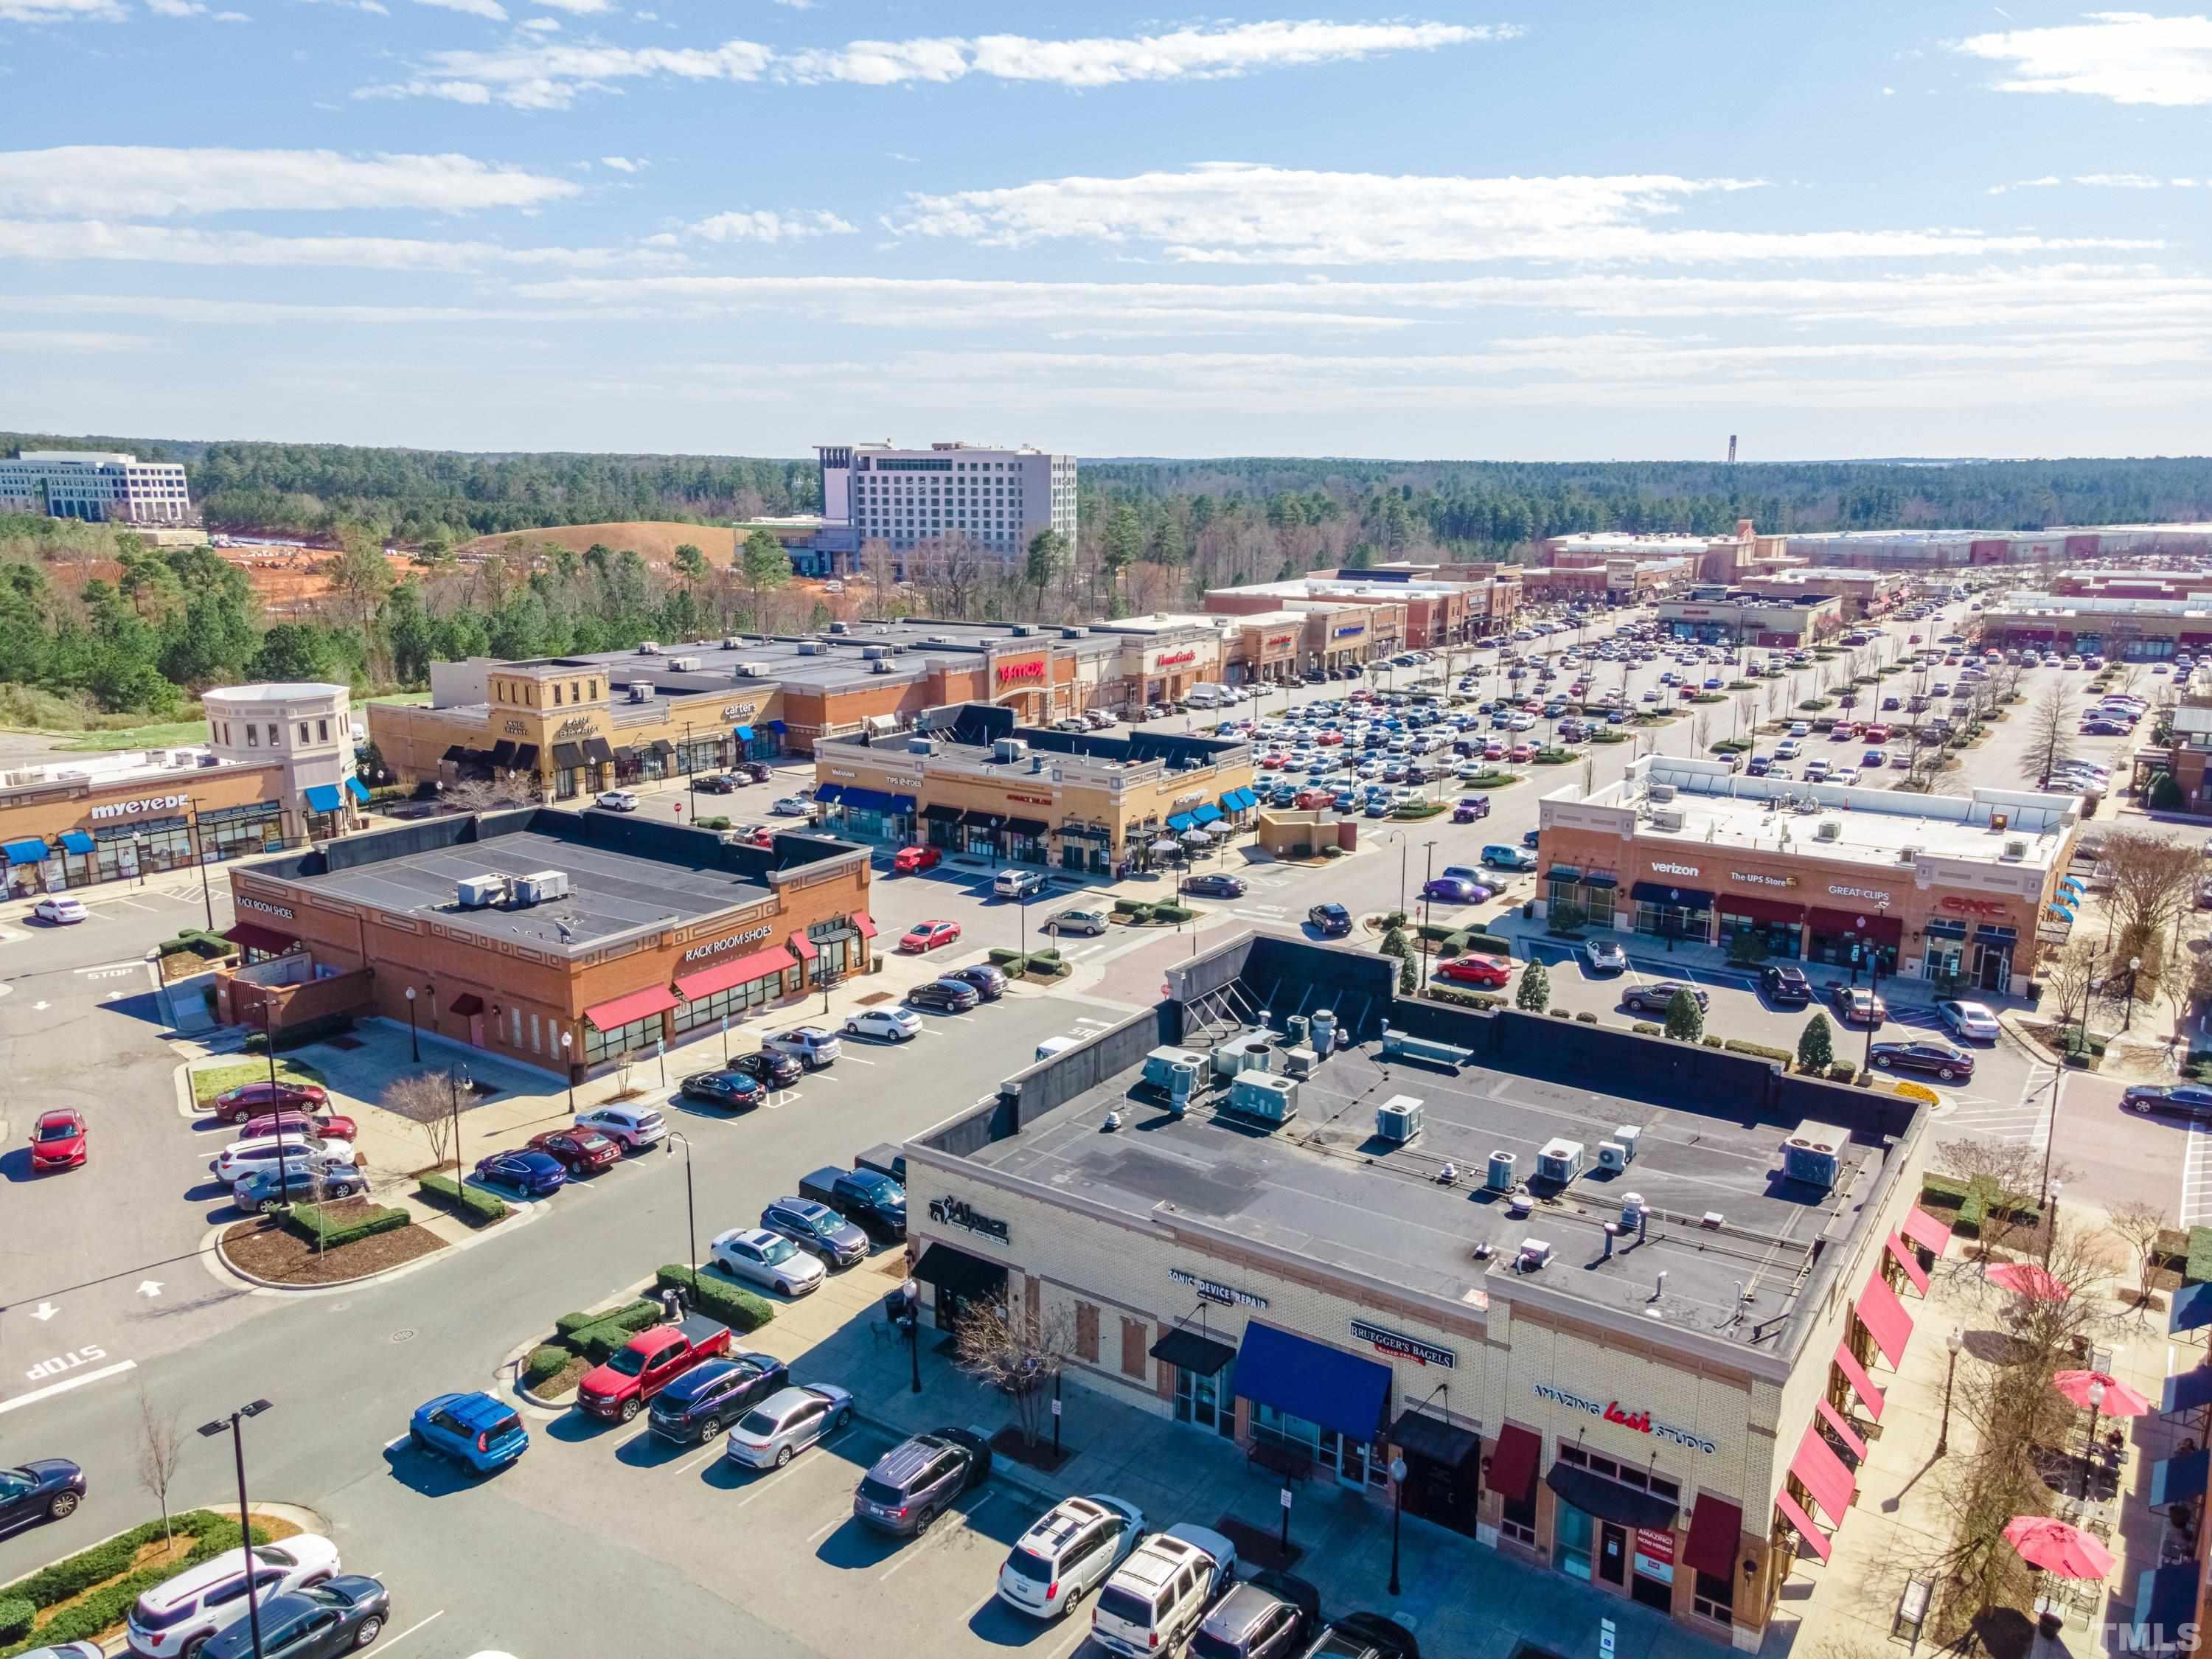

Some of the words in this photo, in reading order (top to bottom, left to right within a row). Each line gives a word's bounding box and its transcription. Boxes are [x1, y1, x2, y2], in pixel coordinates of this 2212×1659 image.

[1652, 862, 1699, 877] verizon
[1731, 872, 1746, 880] The
[1747, 874, 1764, 883] UPS
[1765, 876, 1787, 886] Store
[1829, 886, 1860, 897] GREAT
[1863, 890, 1889, 900] CLIPS
[237, 896, 253, 909] RACK
[254, 900, 273, 914] ROOM
[273, 905, 294, 919] SHOES
[1941, 897, 2006, 916] GNC
[684, 944, 712, 961] RACK
[713, 934, 745, 953] ROOM
[744, 925, 773, 943] SHOES
[87, 968, 133, 980] STOP
[1167, 1270, 1194, 1287] SONIC
[1199, 1281, 1230, 1299] DEVICE
[1235, 1292, 1267, 1310] REPAIR
[1350, 1326, 1411, 1352] BRUEGGER'S
[1413, 1345, 1451, 1368] BAGELS
[25, 1344, 107, 1380] STOP
[1534, 1385, 1600, 1416] AMAZING
[1656, 1426, 1717, 1455] STUDIO
